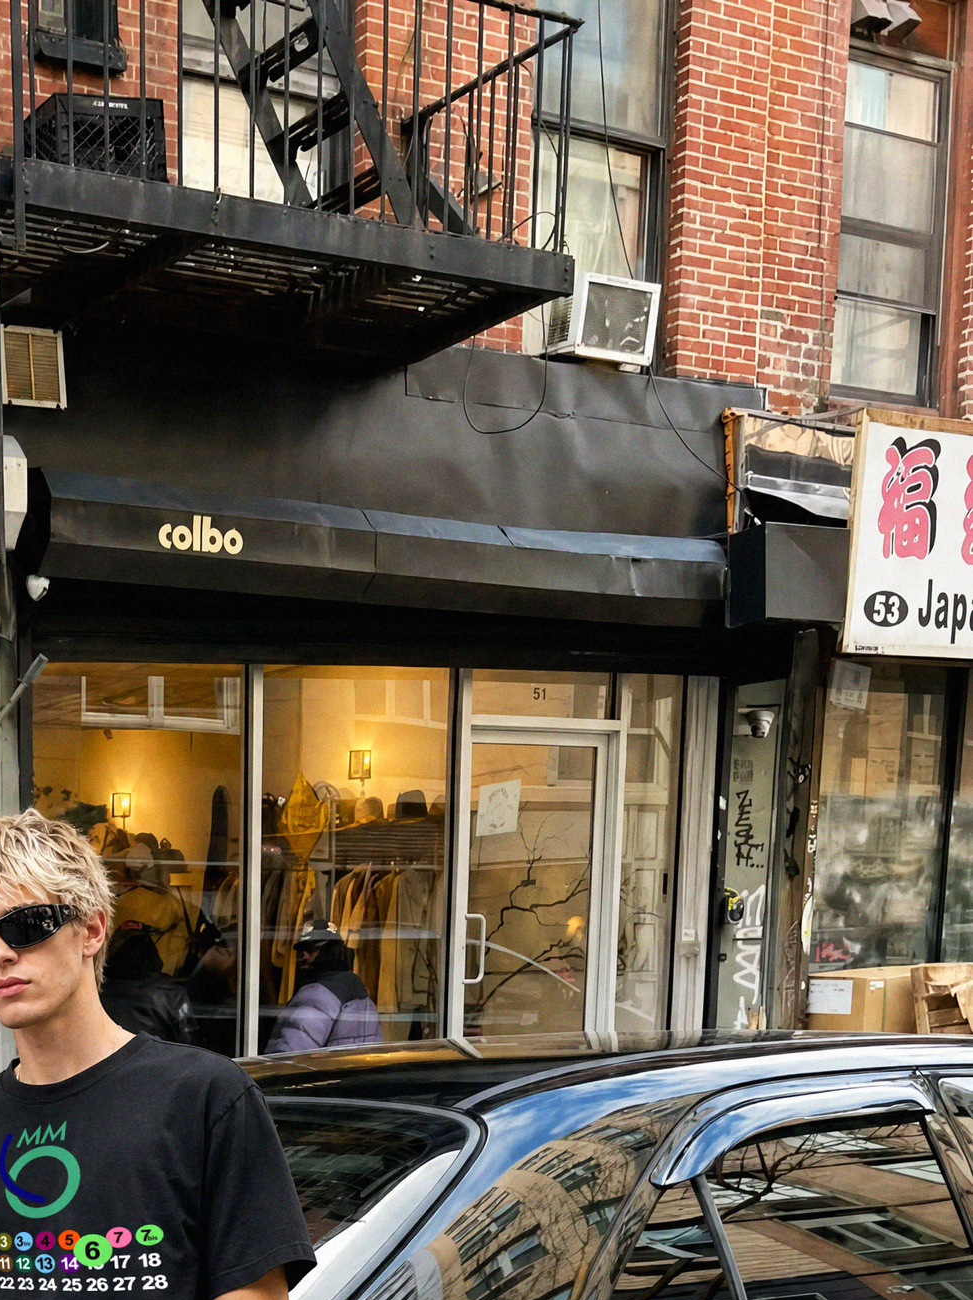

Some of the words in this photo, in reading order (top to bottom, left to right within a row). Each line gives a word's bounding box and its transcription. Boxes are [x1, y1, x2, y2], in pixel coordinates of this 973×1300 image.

[158, 514, 244, 555] colbo
[872, 593, 901, 624] 53
[917, 578, 973, 645] Jap
[532, 686, 547, 701] 51
[16, 1121, 67, 1148] MM
[0, 1235, 8, 1248] 3
[40, 1234, 50, 1247] 4
[64, 1234, 74, 1246] 5
[85, 1241, 101, 1260] 6
[113, 1231, 124, 1244] 7
[16, 1257, 31, 1270] 12
[36, 1256, 53, 1270] 13
[60, 1256, 79, 1270] 14
[109, 1254, 131, 1270] 17
[138, 1252, 162, 1268] 18
[17, 1276, 35, 1291] 23
[37, 1277, 58, 1291] 24
[61, 1277, 83, 1292] 25
[85, 1277, 109, 1292] 26
[112, 1276, 137, 1292] 27
[140, 1274, 169, 1290] 28
